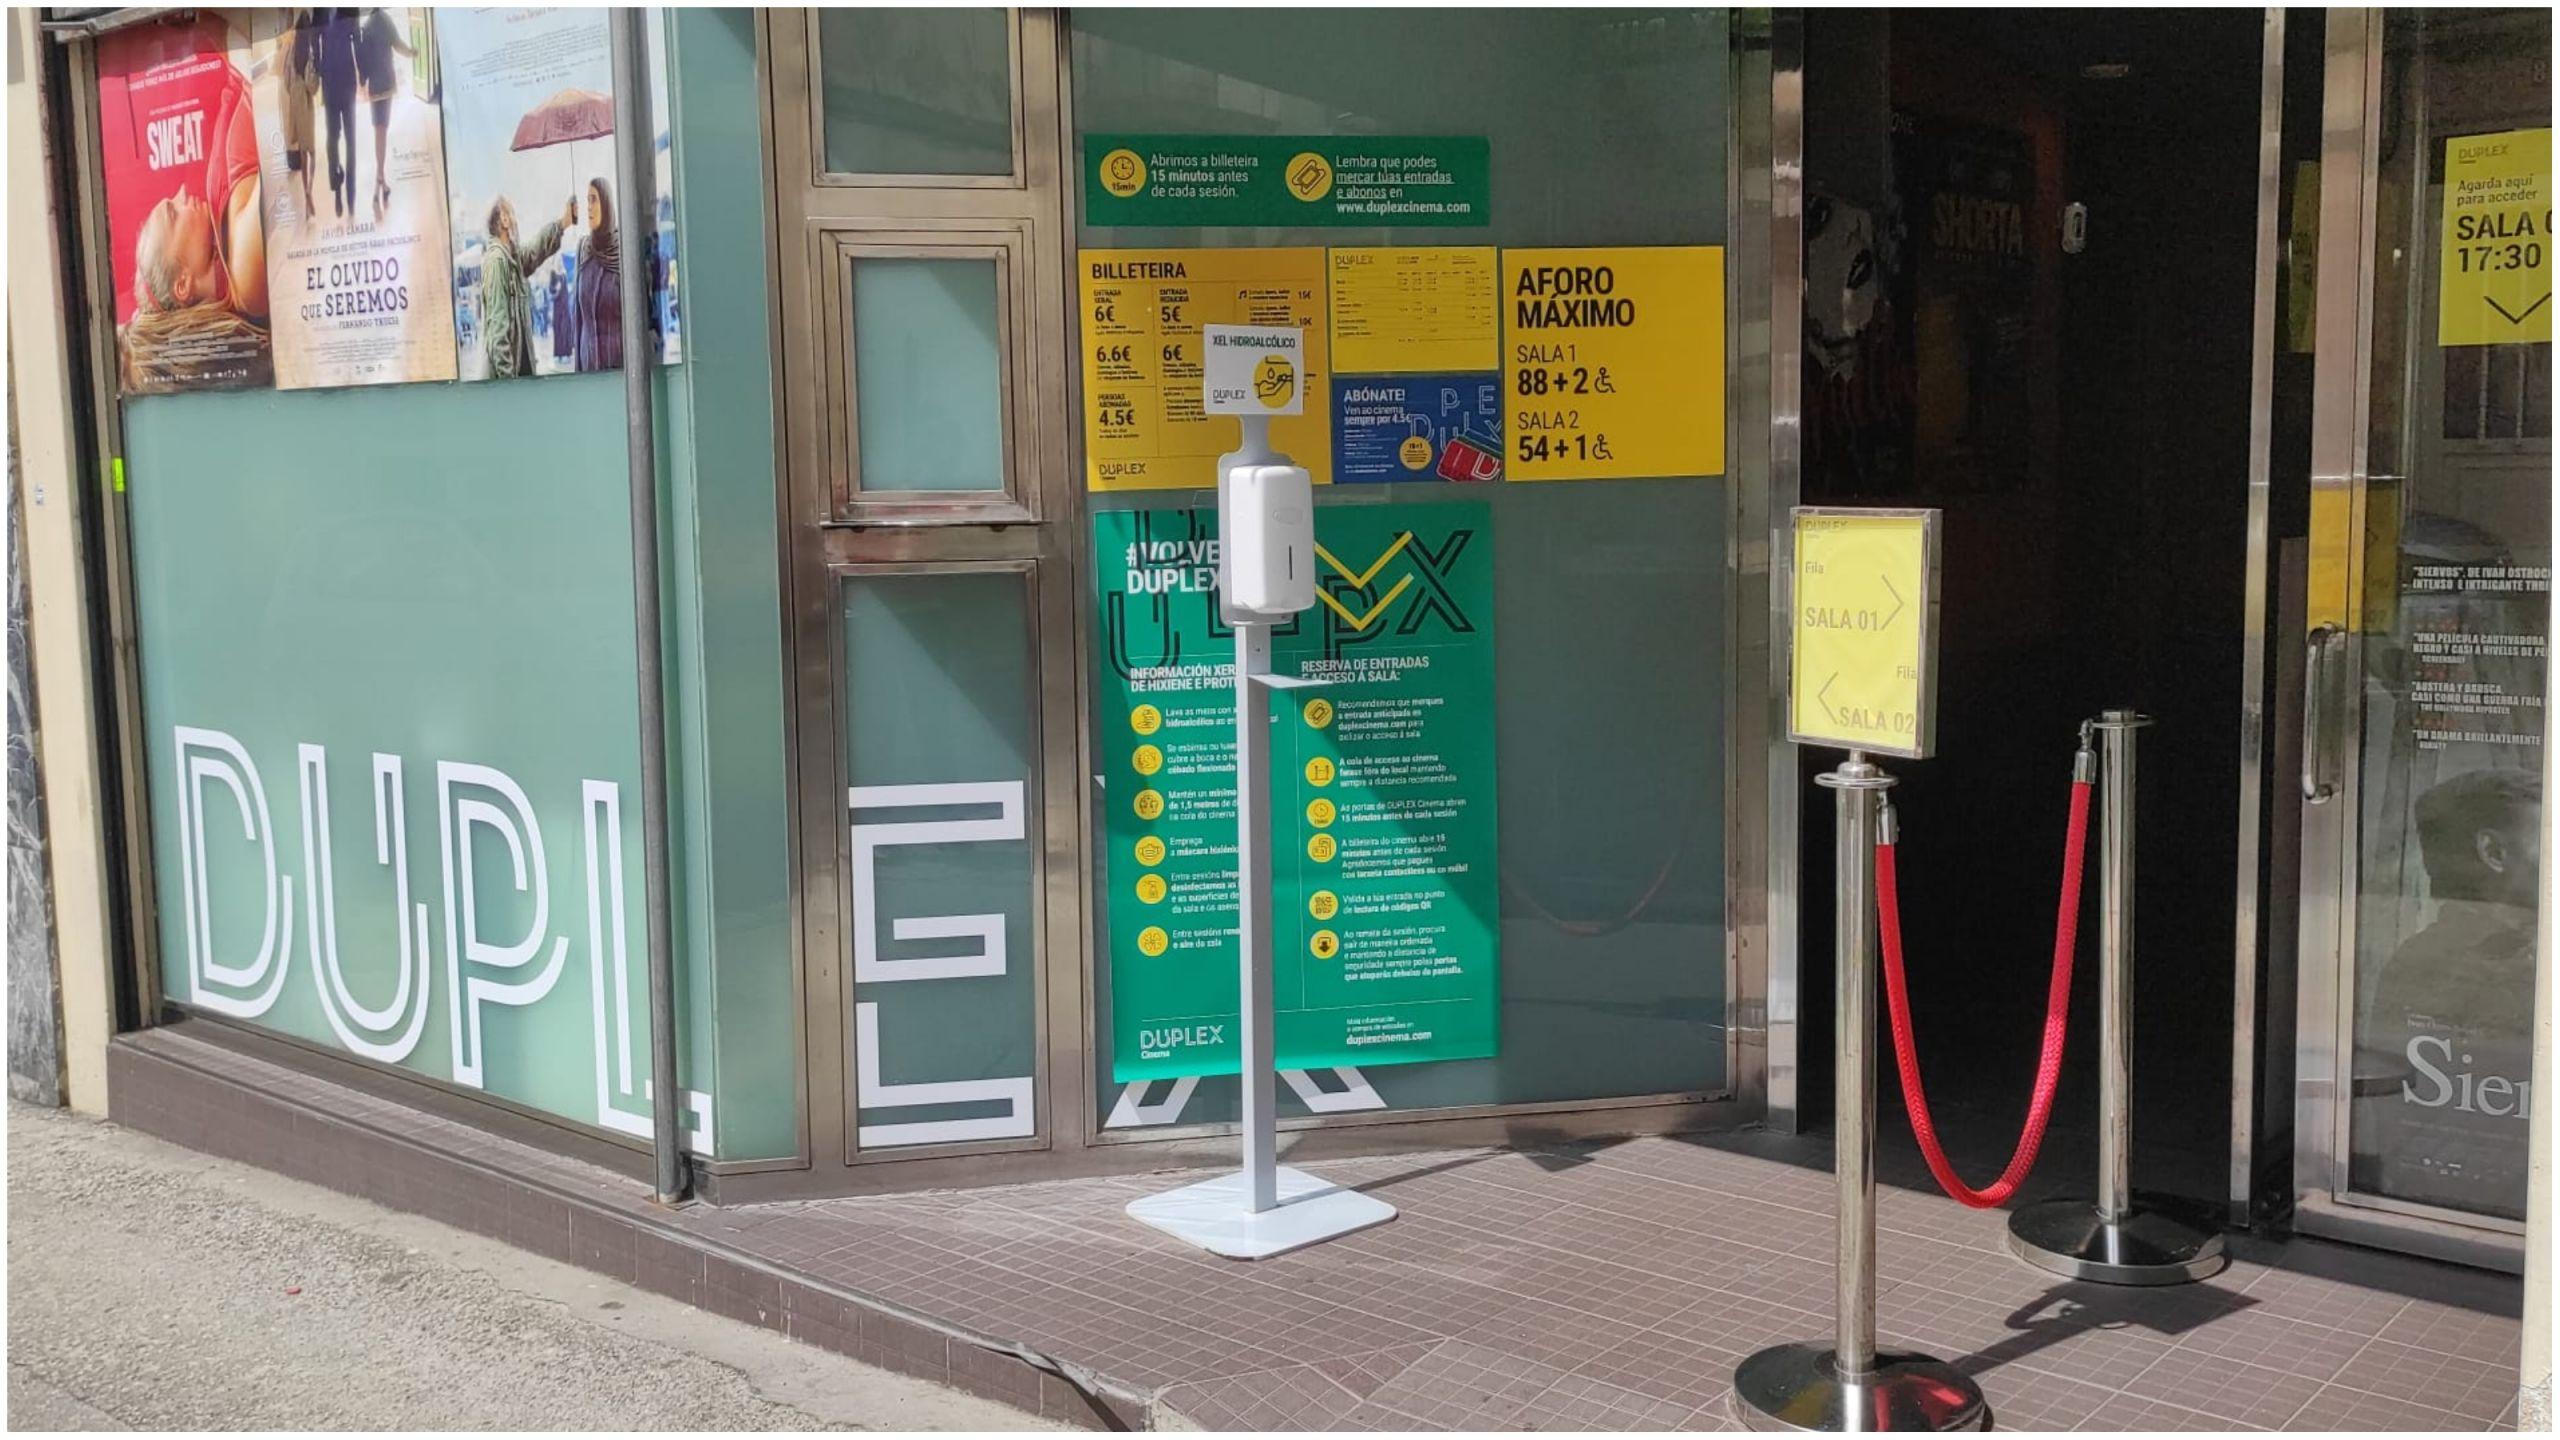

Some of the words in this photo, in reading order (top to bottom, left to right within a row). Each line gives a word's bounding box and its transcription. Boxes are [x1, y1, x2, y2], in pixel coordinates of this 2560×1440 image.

[147, 109, 204, 171] SWEAT
[2459, 144, 2509, 159] DUPLEX
[1151, 154, 1198, 167] Abrimos
[1211, 154, 1258, 167] billeteira
[1336, 155, 1377, 168] Lembra
[1380, 158, 1400, 173] que
[1403, 156, 1437, 170] podes
[1152, 170, 1165, 182] 15
[1169, 170, 1215, 182] minutos
[1218, 169, 1248, 182] antes
[1336, 172, 1374, 184] mercar
[1404, 170, 1452, 184] entradas
[1151, 184, 1165, 198] de
[1168, 184, 1195, 198] cada
[1199, 184, 1239, 198] sesión.
[1348, 186, 1387, 199] abonos
[1389, 187, 1403, 199] en
[2458, 180, 2502, 194] Agarda
[2457, 194, 2484, 208] para
[2488, 191, 2538, 205] acceder
[1336, 201, 1471, 216] www.duplexcinema.com
[2457, 211, 2534, 241] SALA
[2458, 243, 2541, 273] 17:30
[307, 266, 325, 290] EL
[330, 257, 399, 288] OLVIDO
[1092, 262, 1187, 279] BILLETEIRA
[1516, 266, 1614, 296] AFORO
[301, 303, 322, 321] QUE
[325, 286, 409, 318] SEREMOS
[1517, 292, 1635, 328] MÁXIMO
[1095, 305, 1115, 322] 6€
[1161, 305, 1181, 322] 5€
[1213, 335, 1228, 346] XEL
[1230, 335, 1296, 348] HIDROALCÓLICO
[1097, 346, 1131, 362] 6.6€
[1163, 345, 1183, 361] 6€
[1517, 344, 1564, 363] SALA
[1568, 344, 1576, 362] 1
[1517, 368, 1548, 395] 88
[1213, 390, 1246, 400] DUPLEX
[1344, 386, 1406, 402] ABÓNATE!
[1099, 409, 1135, 426] 4.5€
[1344, 405, 1361, 415] Ven
[1362, 406, 1372, 415] ao
[1373, 404, 1404, 415] cinema
[1344, 416, 1375, 427] sempre
[1377, 415, 1391, 427] por
[1518, 411, 1565, 430] SALA
[1569, 410, 1579, 428] 2
[1518, 435, 1549, 462] 54
[1099, 462, 1146, 475] DUPLEX
[1805, 560, 1824, 574] Fila
[2468, 567, 2480, 578] DE
[2507, 567, 2551, 579] OSTROC
[2413, 579, 2454, 590] INTENSO
[2465, 579, 2523, 591] INTRIGANTE
[1806, 607, 1851, 630] SALA
[1858, 609, 1878, 631] 01
[2451, 644, 2473, 655] CASI
[1131, 664, 1211, 679] INFORMACIÓN
[1301, 659, 1352, 673] RESERVA
[1354, 658, 1368, 671] DE
[1370, 656, 1430, 670] ENTRADAS
[1368, 669, 1401, 682] SALA:
[1897, 666, 1918, 680] Fila
[1131, 680, 1150, 692] DE
[1151, 678, 1193, 691] HIXIENE
[1838, 707, 1887, 731] SALA
[1893, 711, 1915, 735] 02
[1140, 1025, 1224, 1050] DUPLEX
[1347, 1031, 1432, 1046] duplexcinema.com
